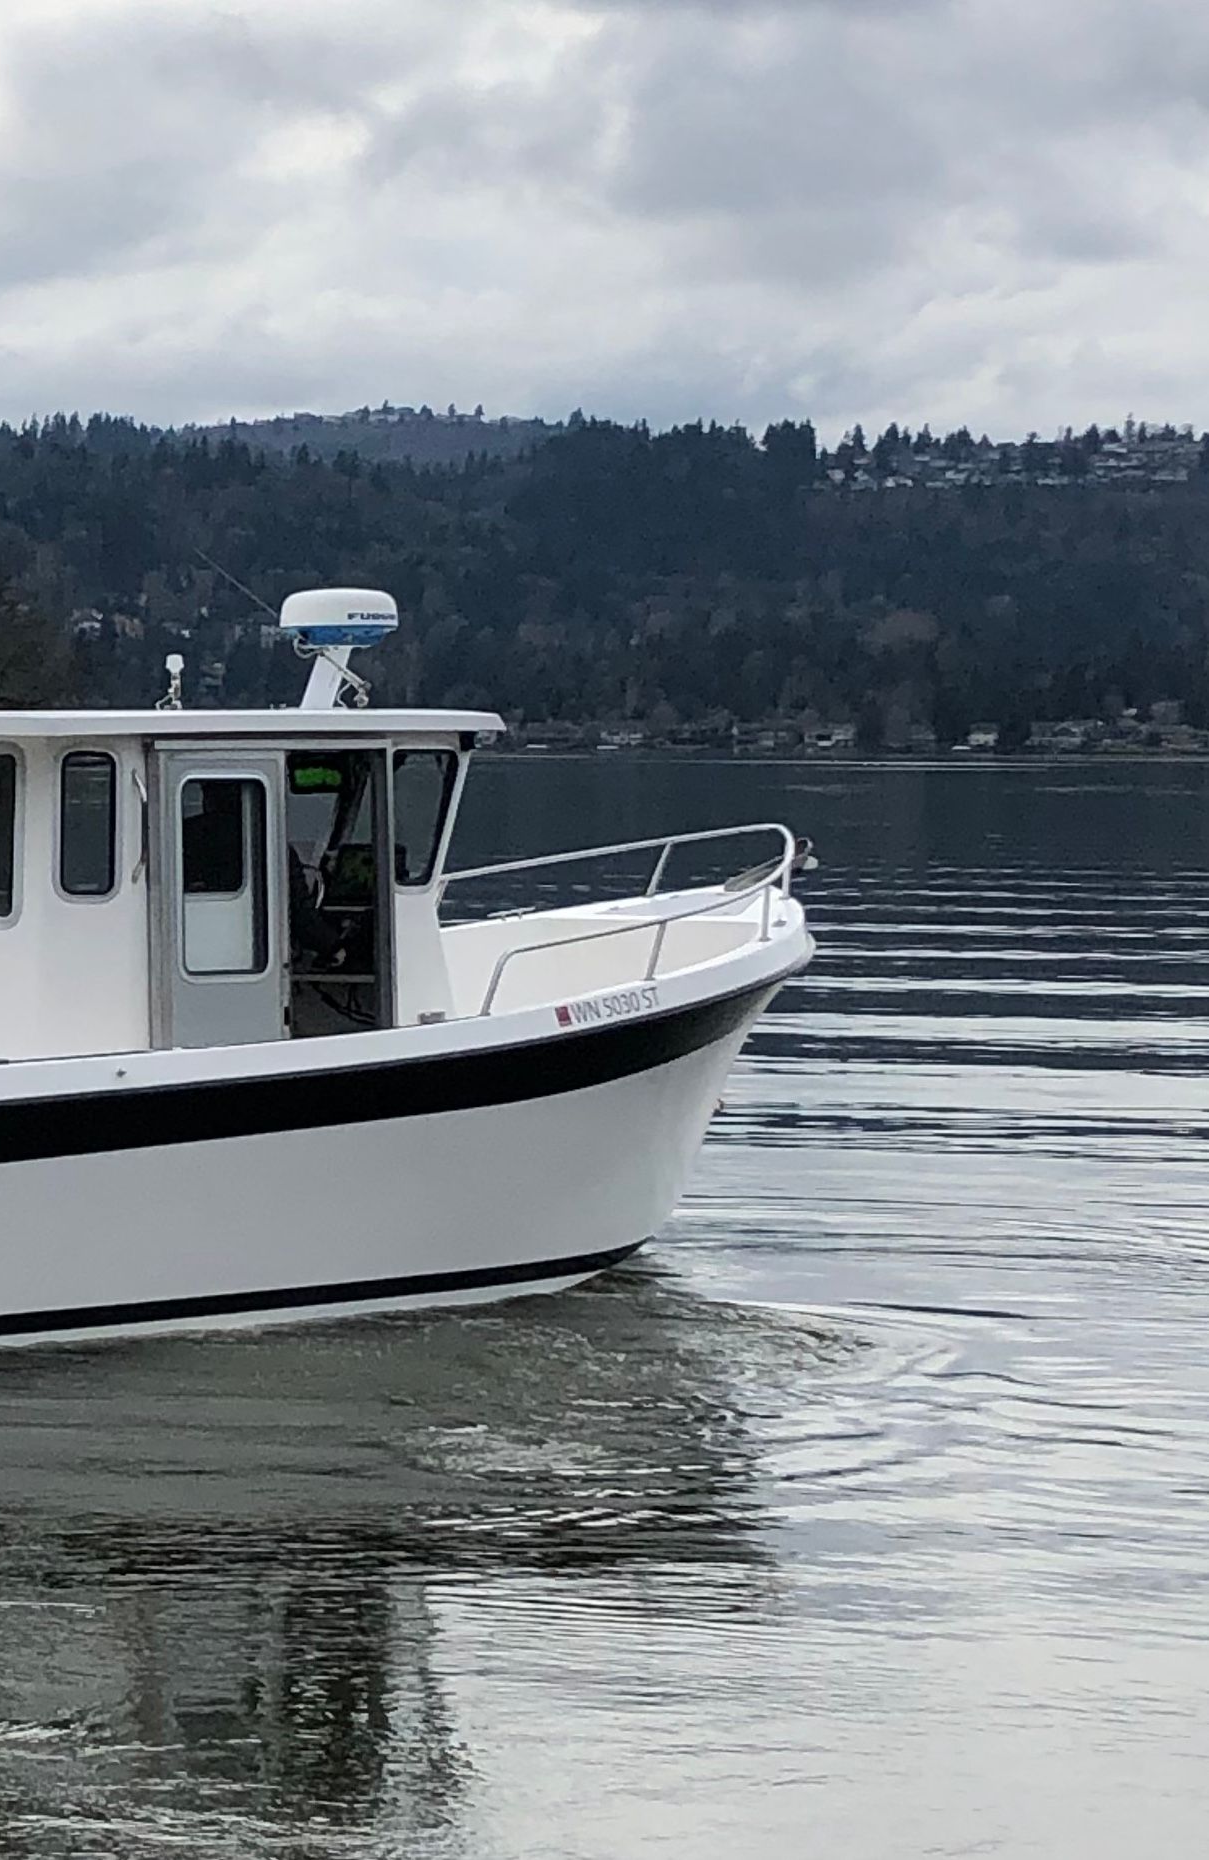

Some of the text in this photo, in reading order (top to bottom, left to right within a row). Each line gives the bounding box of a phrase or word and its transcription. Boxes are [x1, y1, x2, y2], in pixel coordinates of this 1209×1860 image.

[570, 986, 659, 1023] WN 5030 ST
